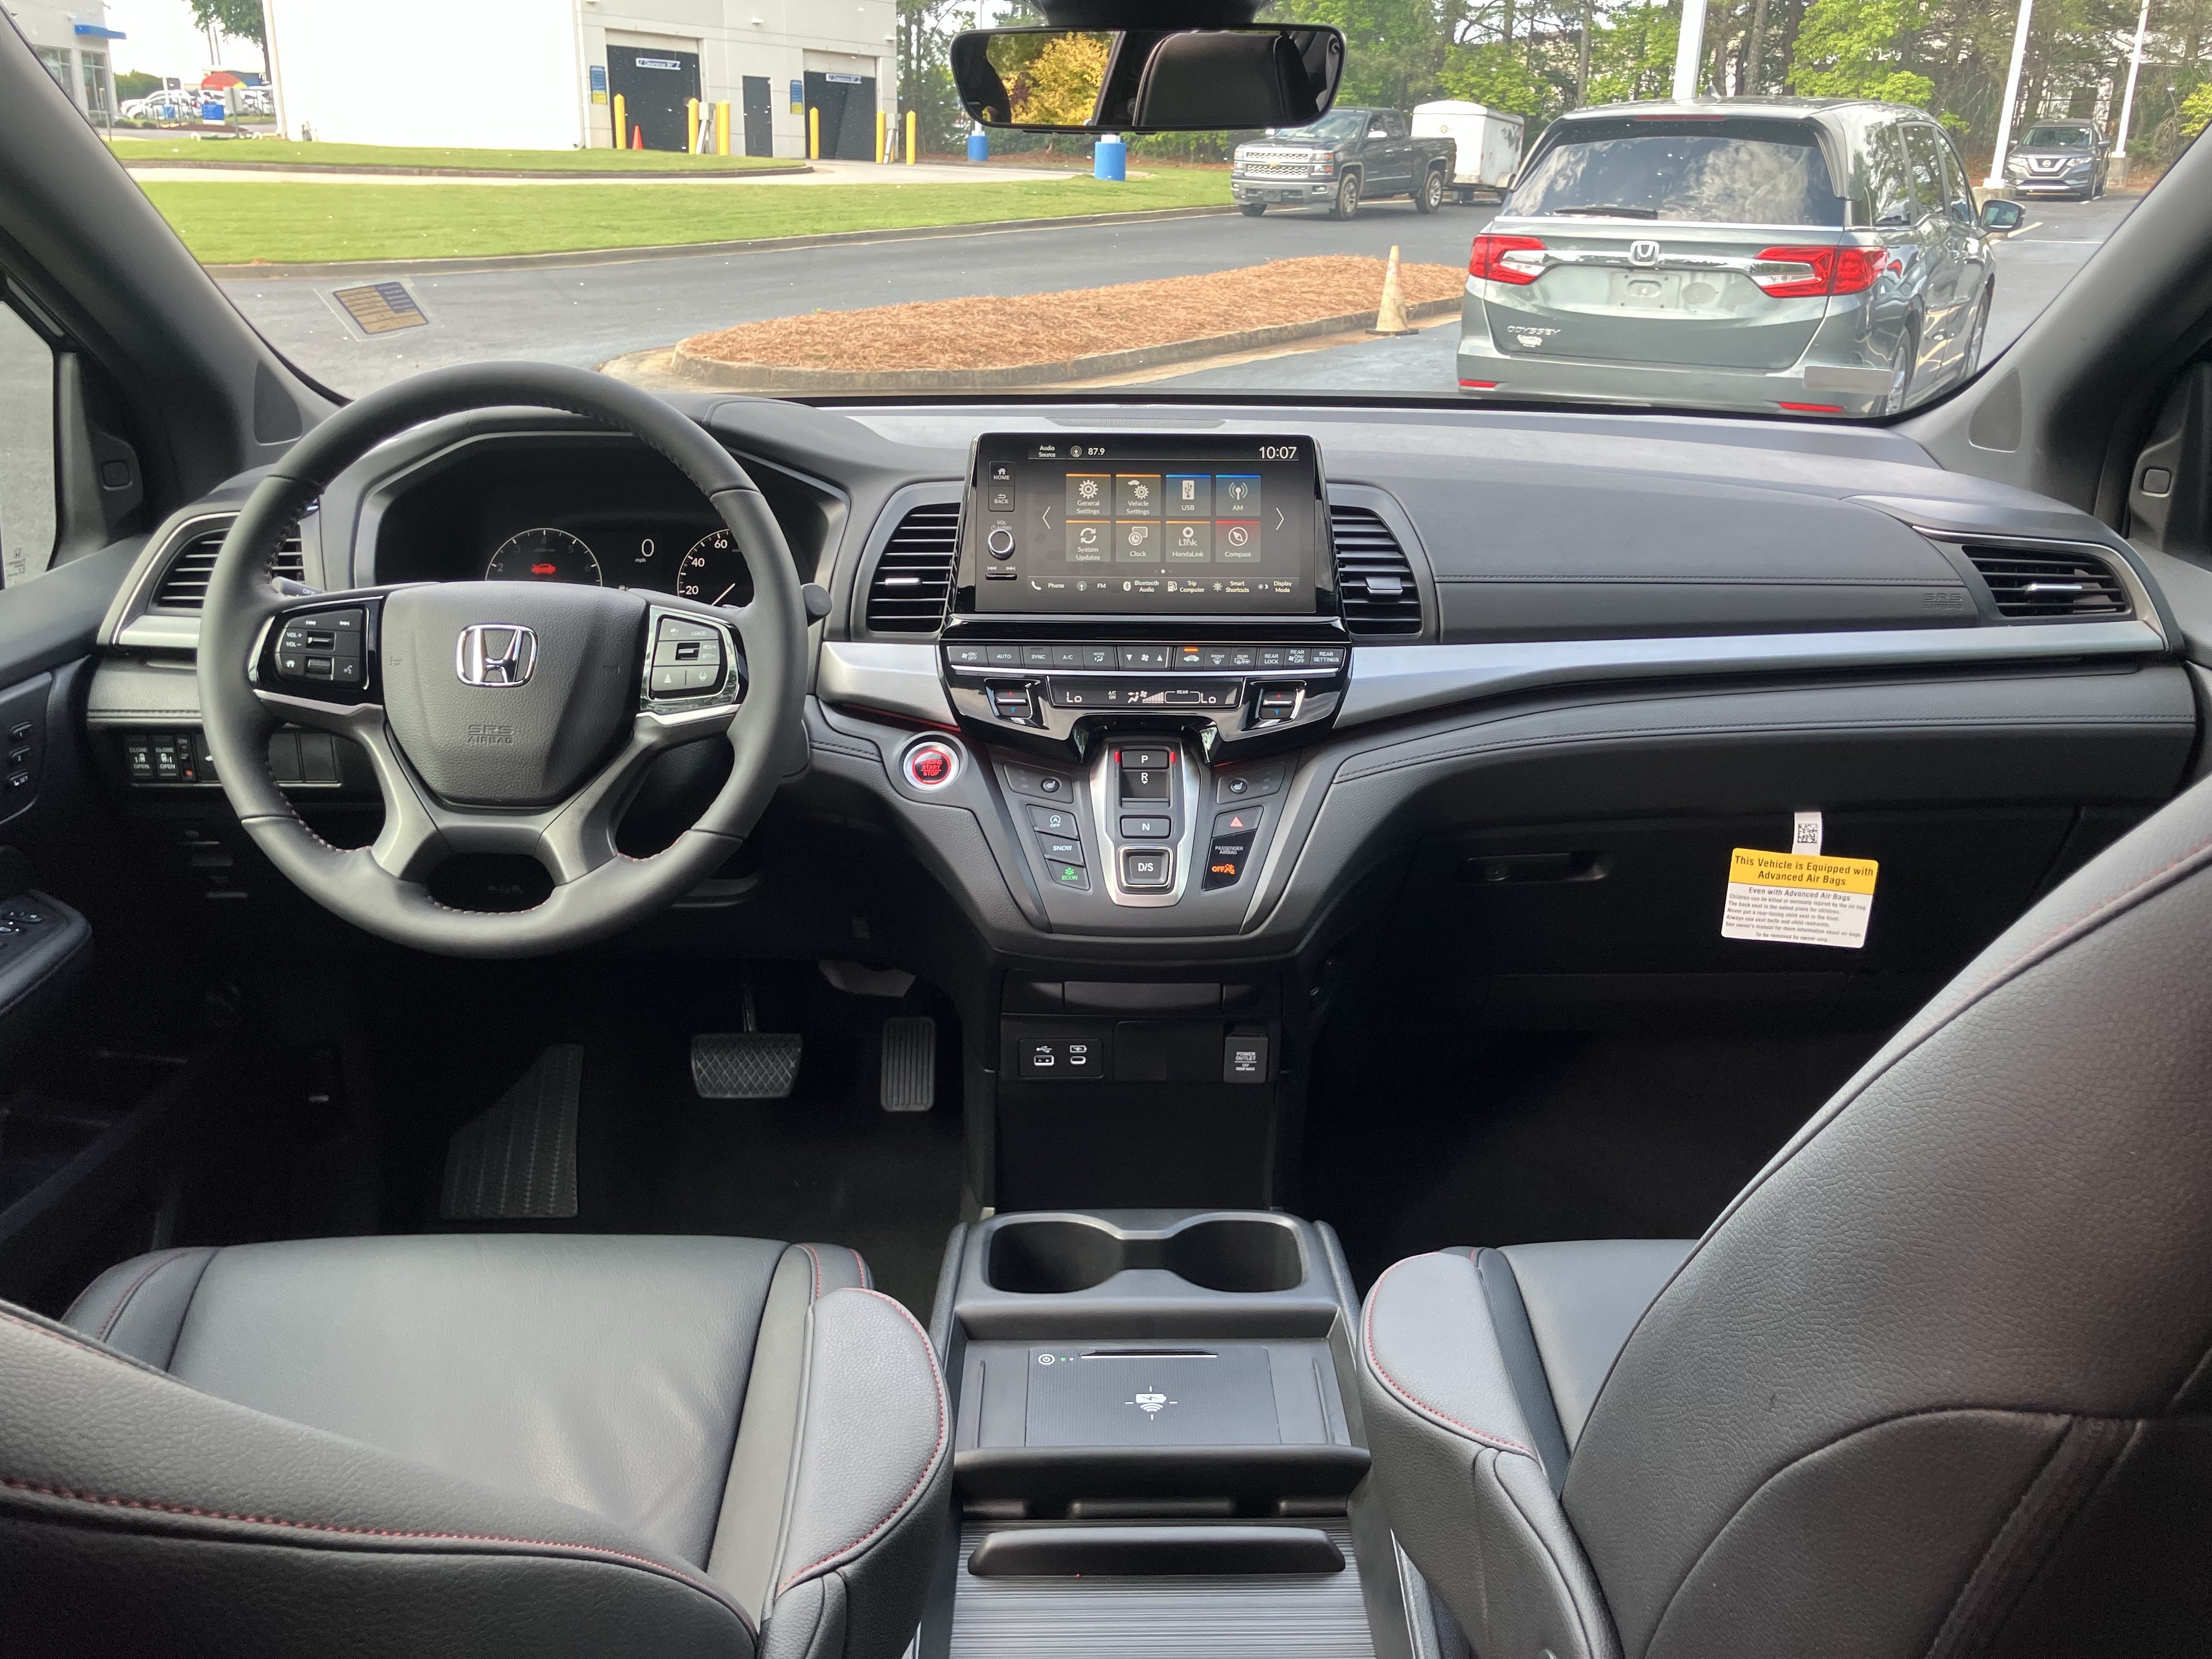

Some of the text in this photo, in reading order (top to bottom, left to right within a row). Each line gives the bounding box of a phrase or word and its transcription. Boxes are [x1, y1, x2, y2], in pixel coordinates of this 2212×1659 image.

[1507, 325, 1561, 335] ODYSSEY
[1259, 446, 1297, 459] 10:07
[641, 538, 654, 557] 0
[714, 540, 727, 549] 60
[692, 558, 705, 567] 40
[498, 563, 504, 572] 2
[686, 585, 698, 595] 20
[1923, 593, 1962, 602] SRS
[469, 725, 514, 735] SRS
[1141, 755, 1148, 764] P
[1138, 863, 1154, 872] D/S
[1735, 856, 1874, 877] This Vehicle is Equipped with
[1758, 871, 1846, 887] Advanced Air Bags
[1784, 890, 1818, 898] Advanced
